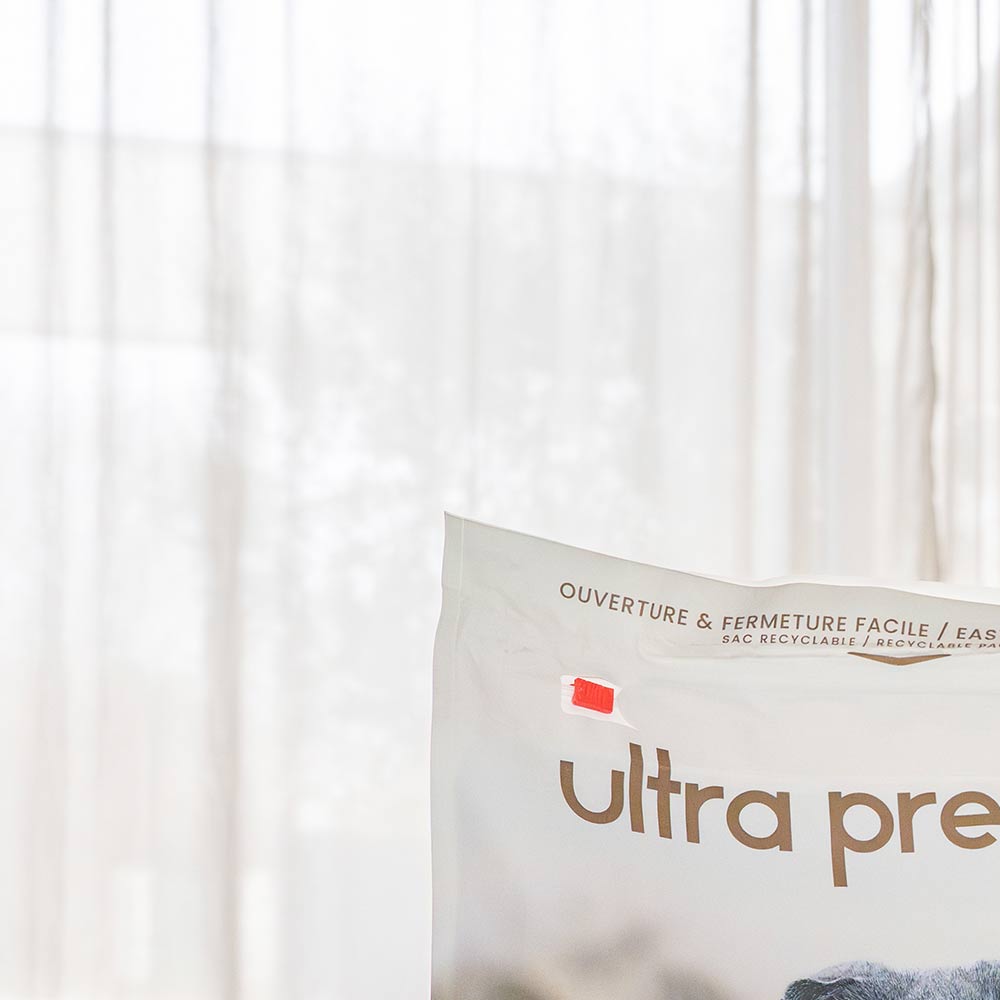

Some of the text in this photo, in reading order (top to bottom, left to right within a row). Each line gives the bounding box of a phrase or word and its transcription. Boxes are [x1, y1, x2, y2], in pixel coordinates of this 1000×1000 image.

[559, 582, 689, 625] OUVERTURE
[696, 613, 712, 630] &
[721, 613, 848, 632] FERMETURE
[855, 617, 930, 637] FACILE
[721, 634, 753, 644] SAC
[760, 634, 856, 646] RECYCLABLE
[877, 638, 971, 649] RECYCLABLE
[559, 742, 793, 852] ultra
